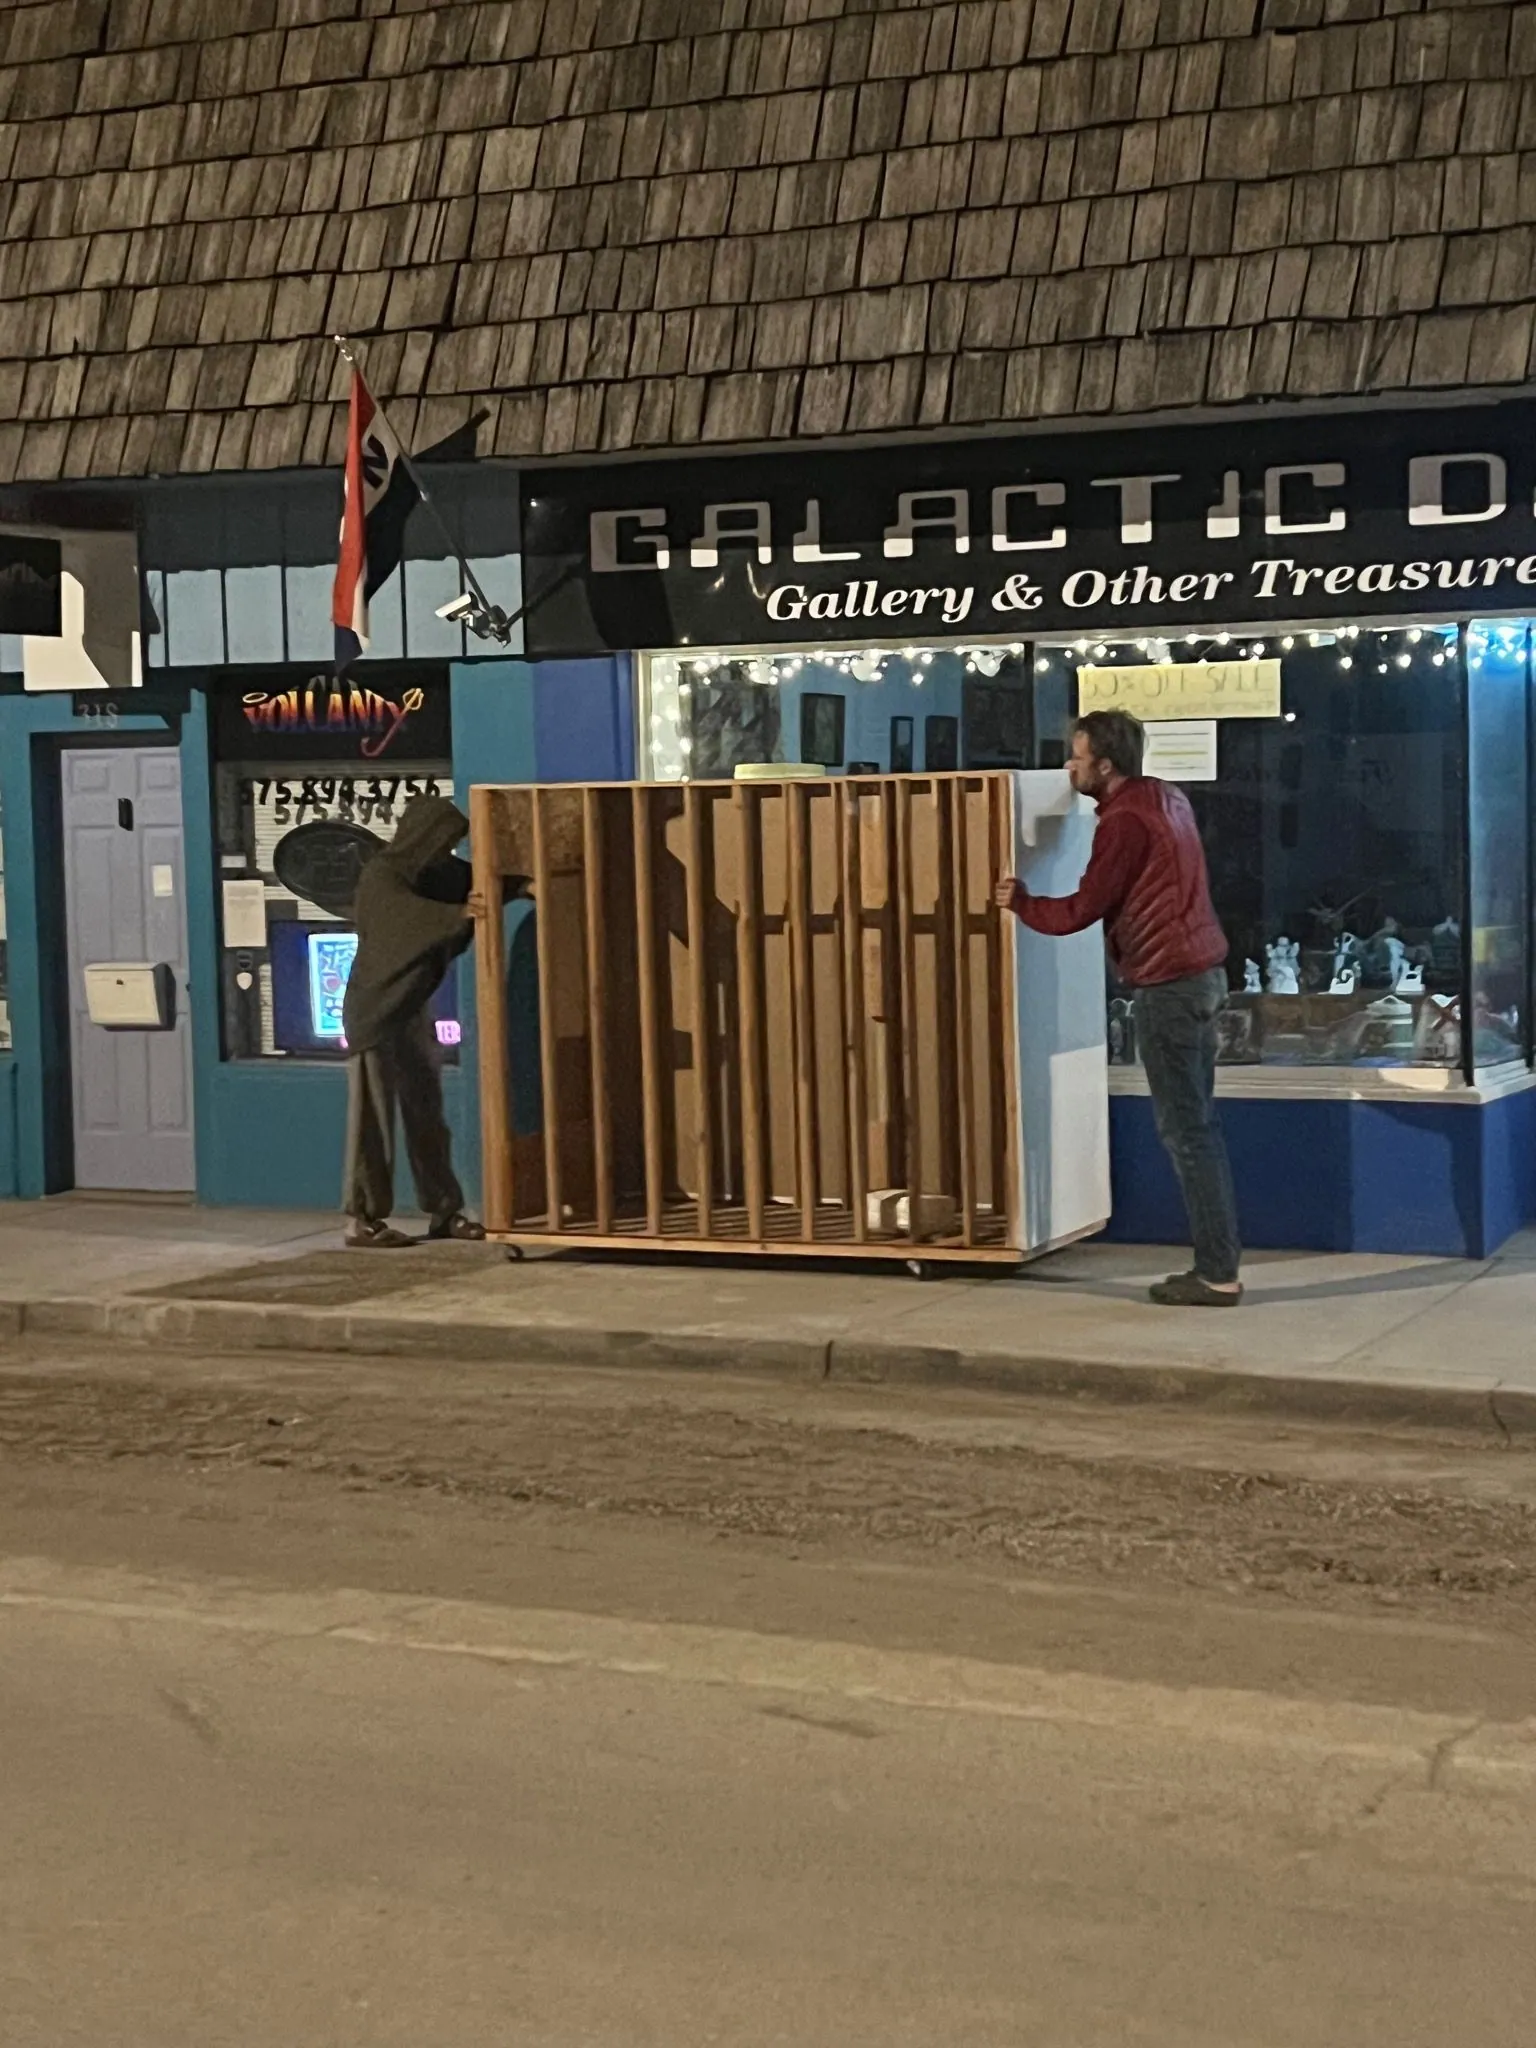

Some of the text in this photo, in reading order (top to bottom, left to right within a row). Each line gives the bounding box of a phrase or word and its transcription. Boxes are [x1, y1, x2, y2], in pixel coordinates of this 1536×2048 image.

[590, 451, 1536, 573] GALACTIC D
[766, 552, 1536, 624] Gallery & Other Treasure
